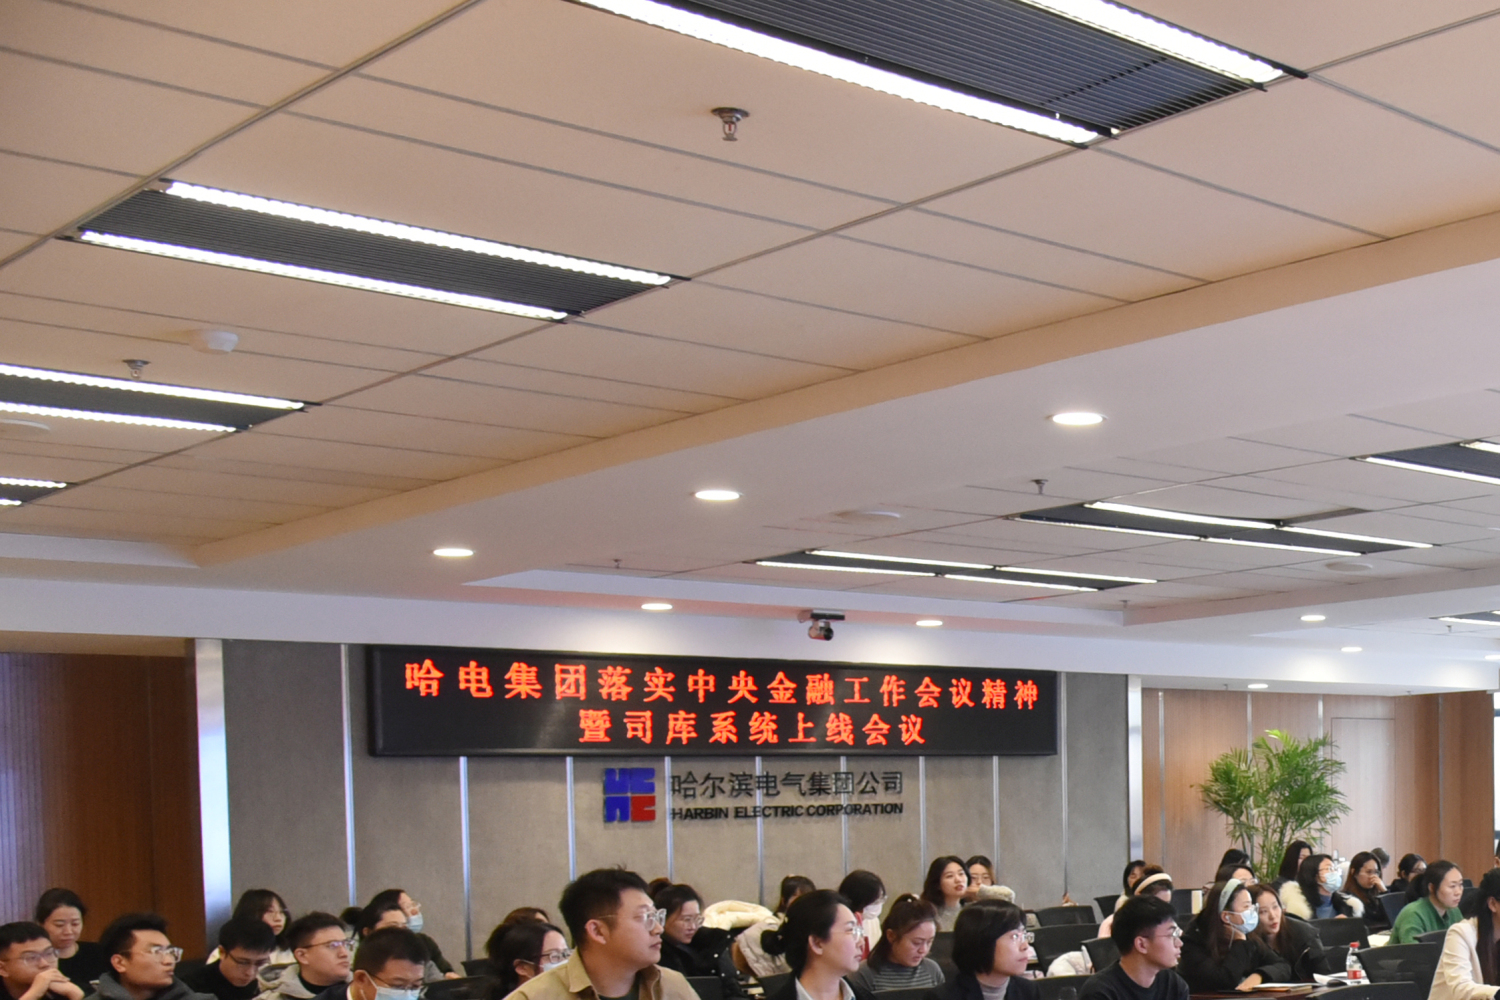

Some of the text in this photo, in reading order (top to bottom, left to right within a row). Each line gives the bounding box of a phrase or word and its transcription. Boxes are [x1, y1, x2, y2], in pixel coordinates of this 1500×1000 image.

[405, 658, 1039, 710] 哈电集团落实中央金融工作会议精神
[578, 708, 926, 745] 暨司库系统上线会议
[671, 770, 903, 799] 哈尔滨电气集团公司
[671, 802, 904, 820] HARBIN ELECTRIC CORPORATION
